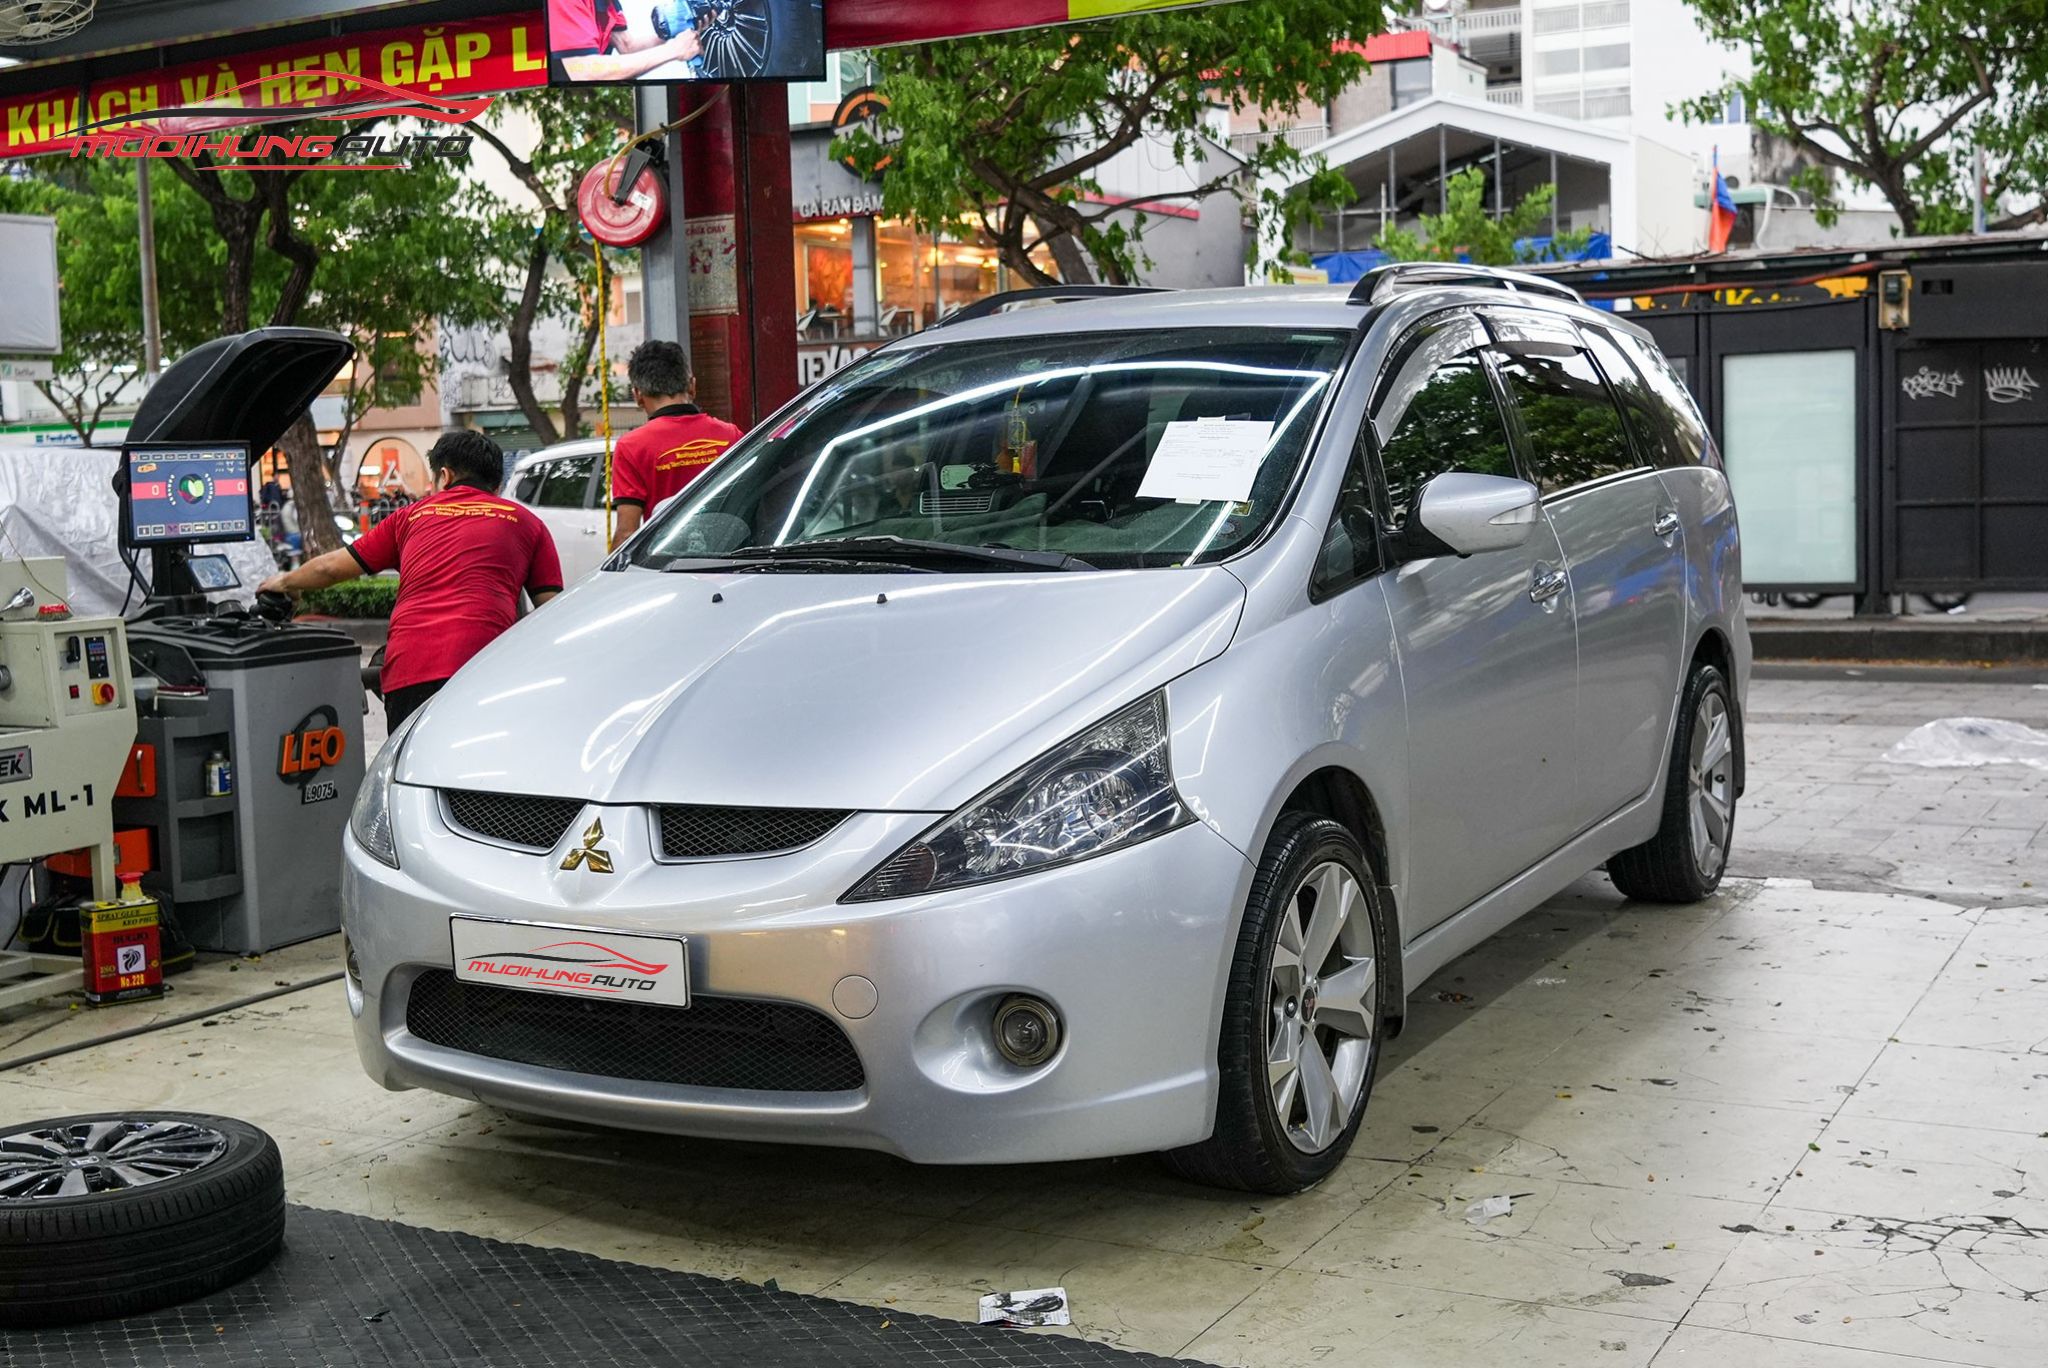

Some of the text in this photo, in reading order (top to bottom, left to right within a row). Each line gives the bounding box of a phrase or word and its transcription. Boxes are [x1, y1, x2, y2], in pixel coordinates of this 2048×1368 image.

[181, 64, 244, 110] VÀ
[259, 48, 361, 109] HẸN
[381, 27, 491, 91] GẶP
[512, 27, 547, 73] L
[279, 726, 346, 775] LEO
[24, 784, 94, 818] ML-1
